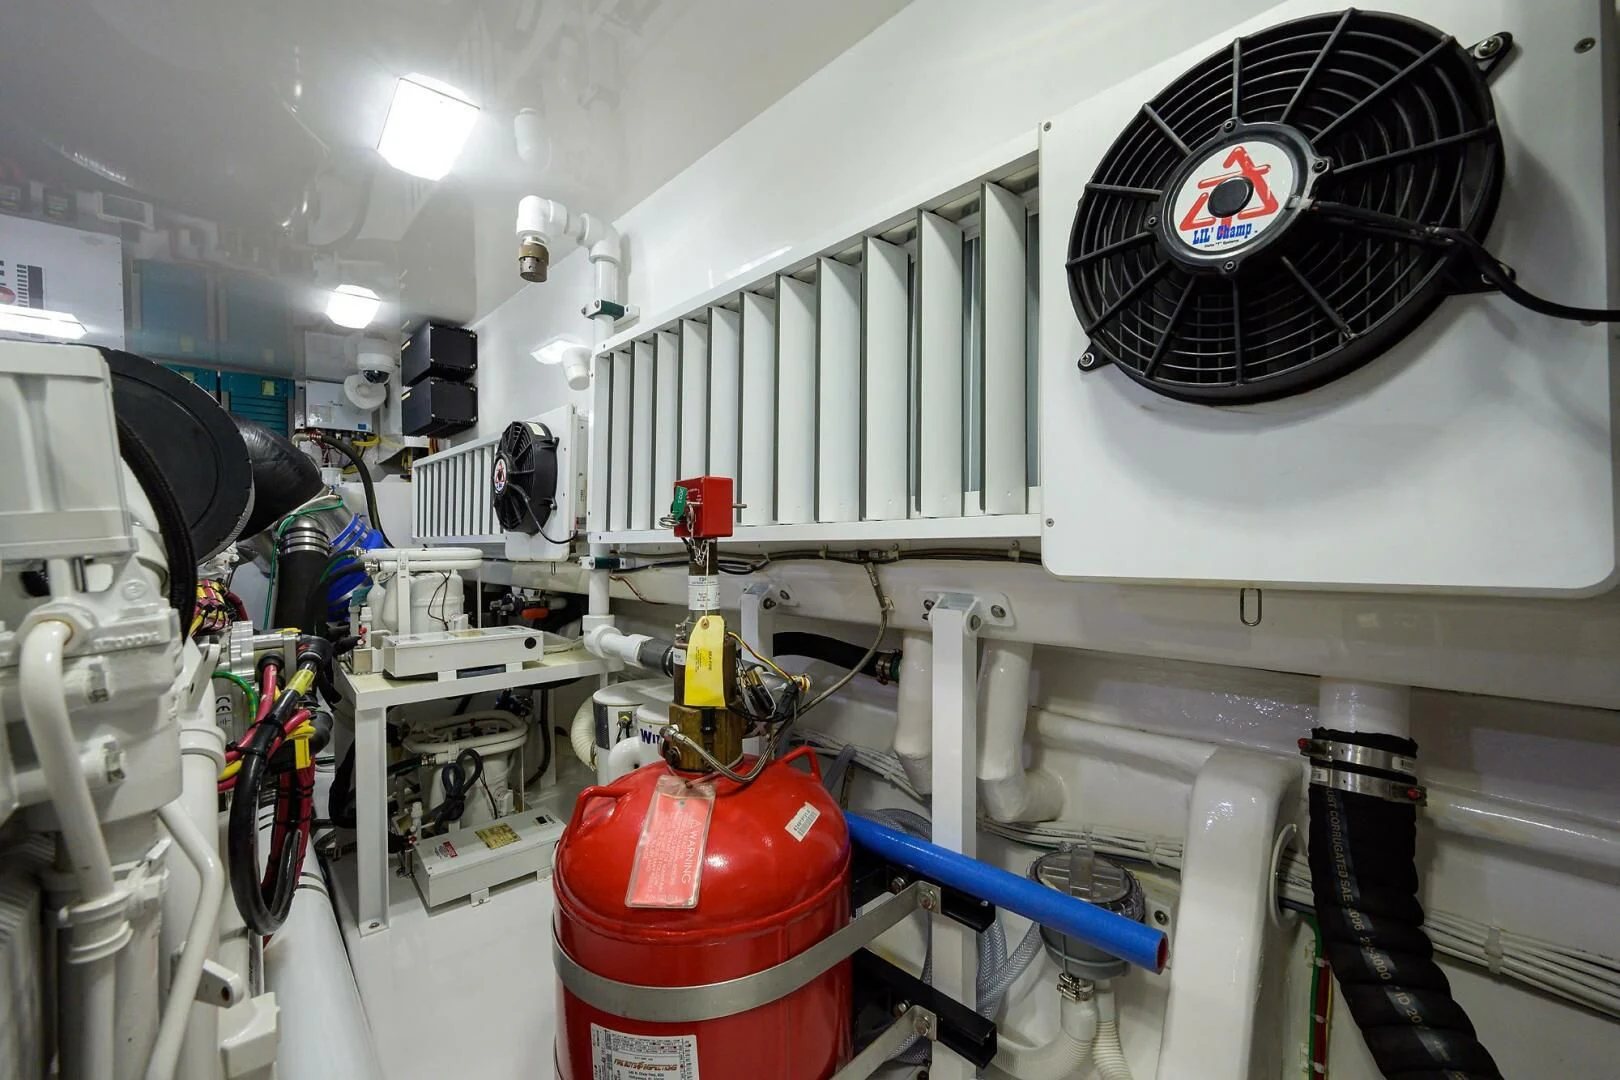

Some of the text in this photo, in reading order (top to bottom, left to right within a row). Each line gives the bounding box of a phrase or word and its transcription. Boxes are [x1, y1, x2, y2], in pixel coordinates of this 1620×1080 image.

[1216, 223, 1252, 240] Champ
[681, 831, 699, 884] WARNING
[1329, 810, 1349, 879] CORRUGATED
